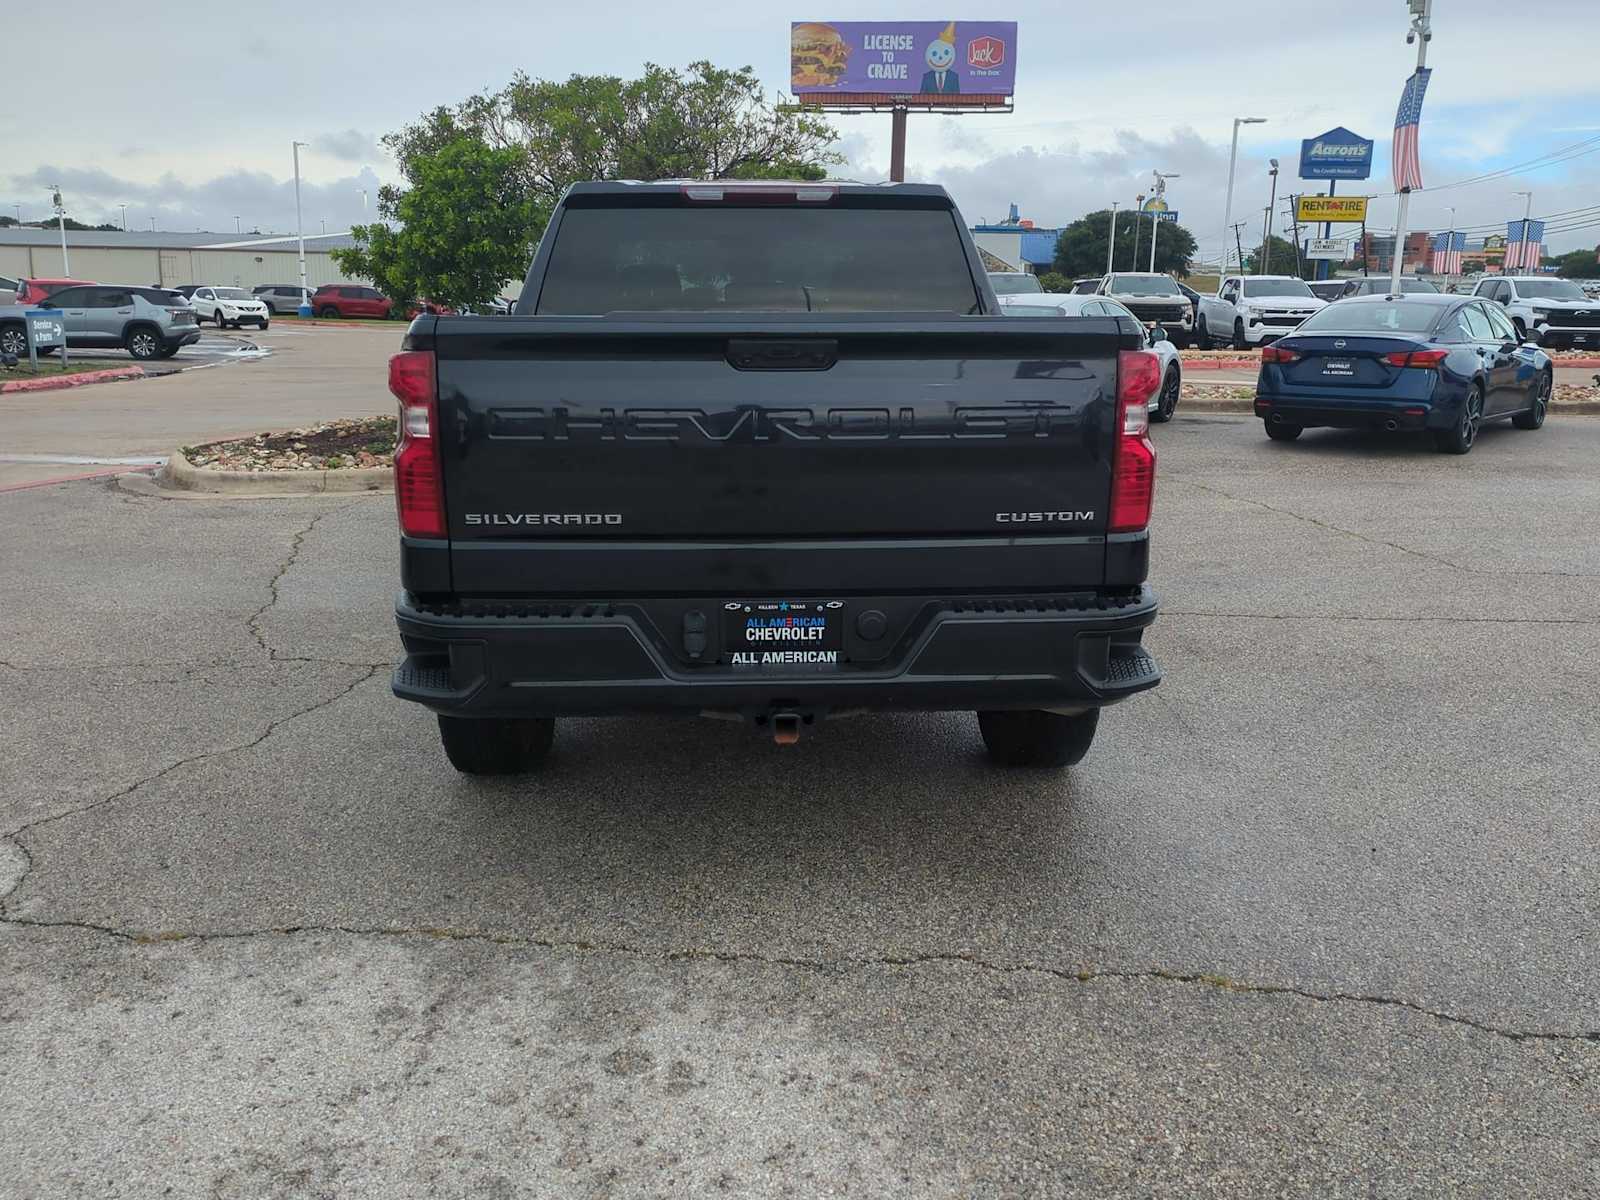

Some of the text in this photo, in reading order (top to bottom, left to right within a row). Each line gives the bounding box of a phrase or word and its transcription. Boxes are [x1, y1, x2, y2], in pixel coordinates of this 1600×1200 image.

[864, 35, 913, 50] LICENSE
[882, 51, 894, 63] TO
[969, 40, 1002, 64] Jack
[868, 63, 908, 79] CRAVE
[1311, 143, 1368, 156] Aaron's
[1302, 200, 1330, 211] RENT
[33, 320, 52, 330] Service
[486, 405, 1072, 440] CHEVROLET
[464, 513, 623, 525] SILVERADO
[995, 510, 1095, 522] CUSTOM
[746, 616, 825, 628] ALL AMERICAN
[745, 627, 825, 641] CHEVROLET
[731, 651, 837, 664] ALL AMERICAN
